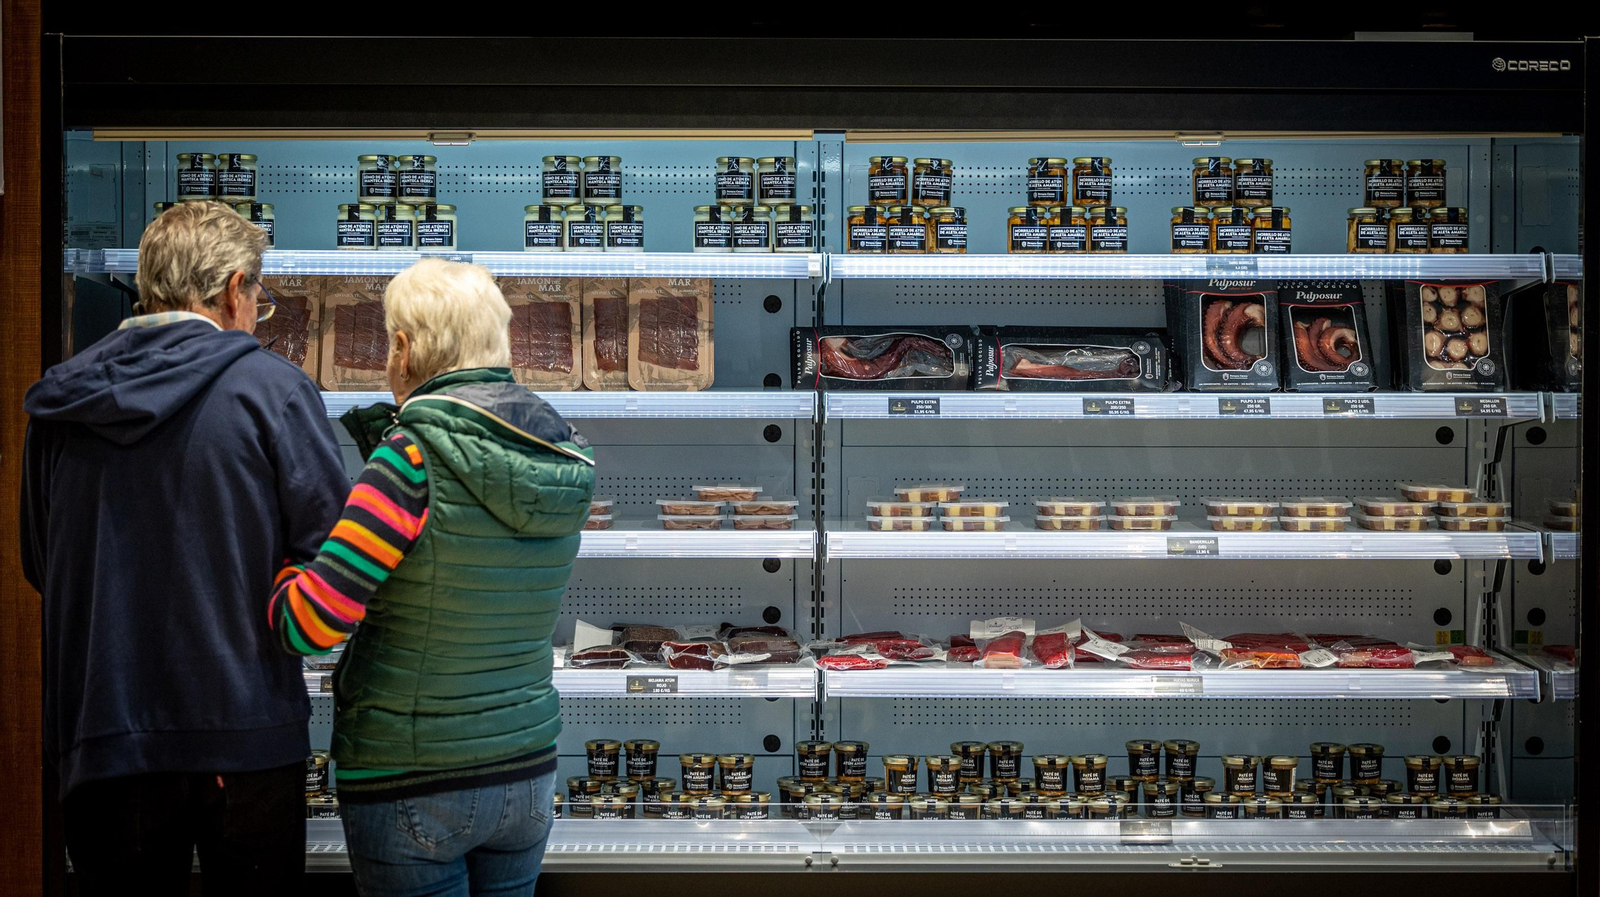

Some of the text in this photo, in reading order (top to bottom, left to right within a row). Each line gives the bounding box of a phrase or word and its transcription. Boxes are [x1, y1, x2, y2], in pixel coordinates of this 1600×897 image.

[1508, 60, 1571, 71] CORECO
[1208, 279, 1256, 291] Pulposur
[1295, 291, 1342, 303] Pulposur
[805, 338, 816, 375] Pulposur
[986, 345, 998, 377] Pulposur
